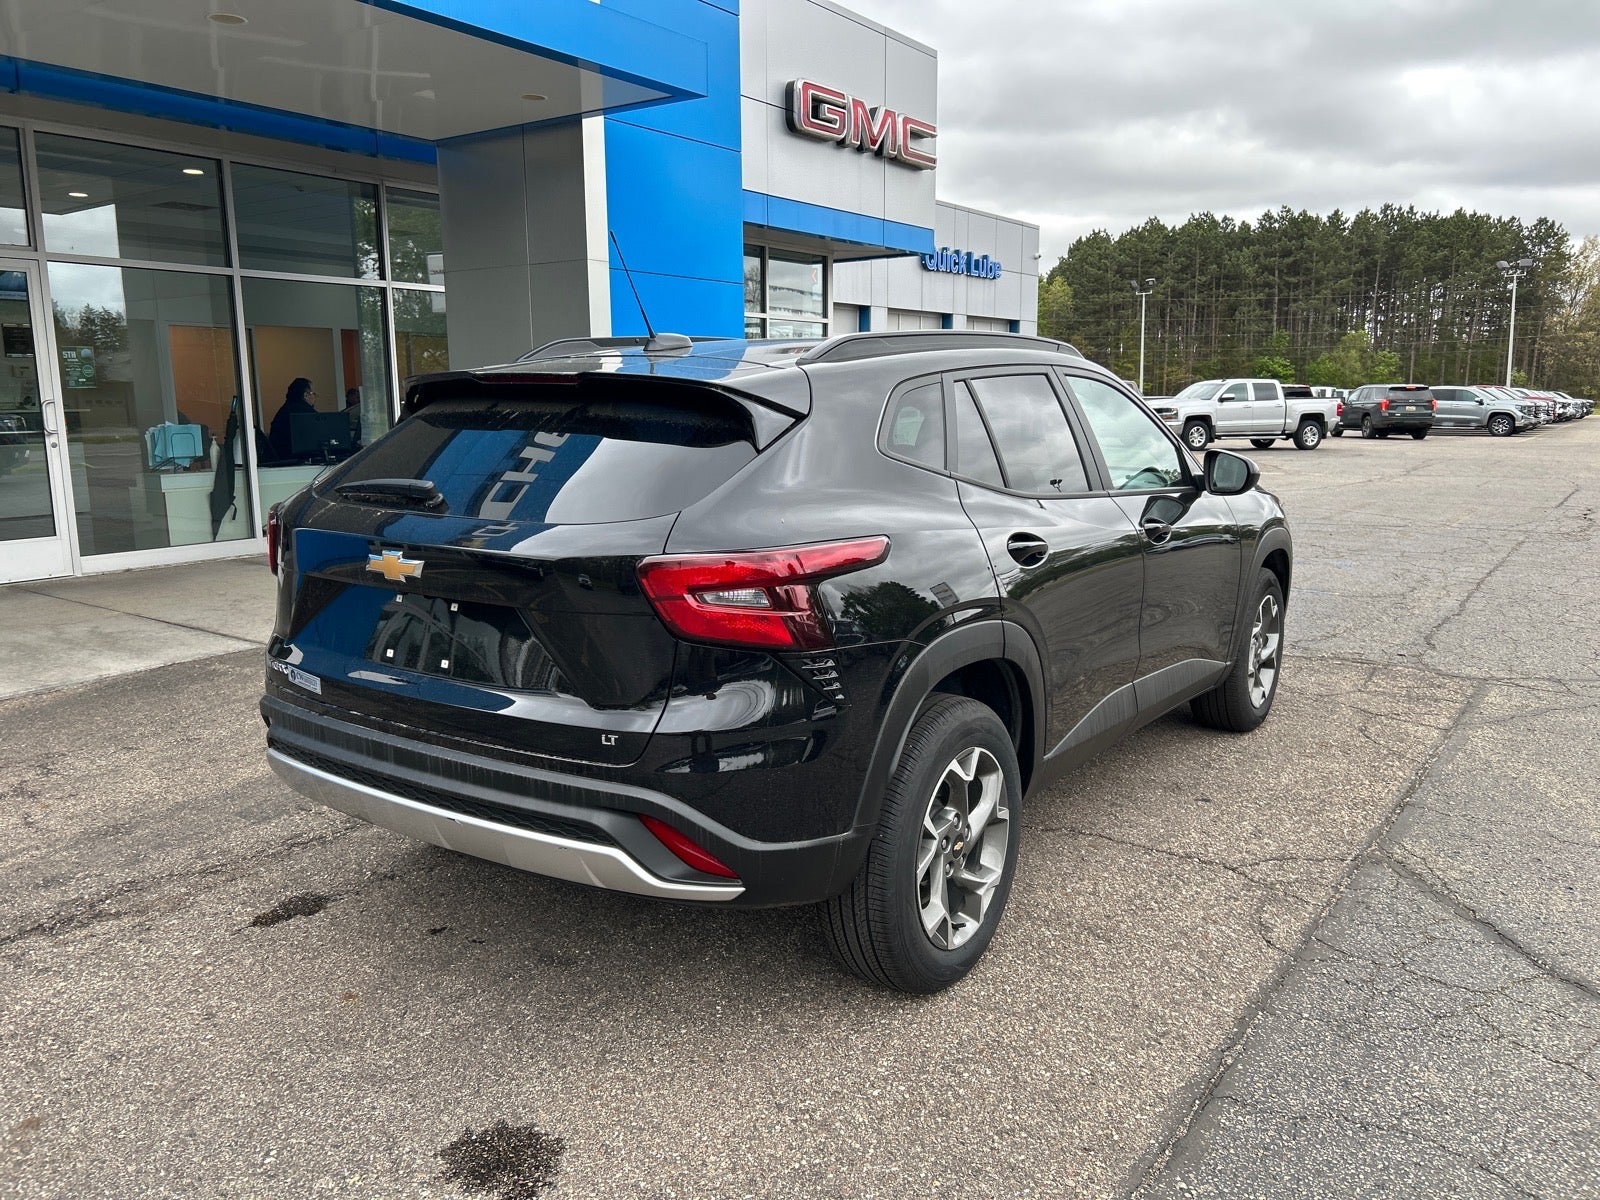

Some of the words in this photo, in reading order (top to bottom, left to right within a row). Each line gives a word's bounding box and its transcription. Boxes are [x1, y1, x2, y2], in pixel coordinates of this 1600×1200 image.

[785, 79, 937, 170] GMC
[923, 248, 968, 274] Quick
[969, 253, 1002, 280] Lube
[601, 734, 619, 746] LT
